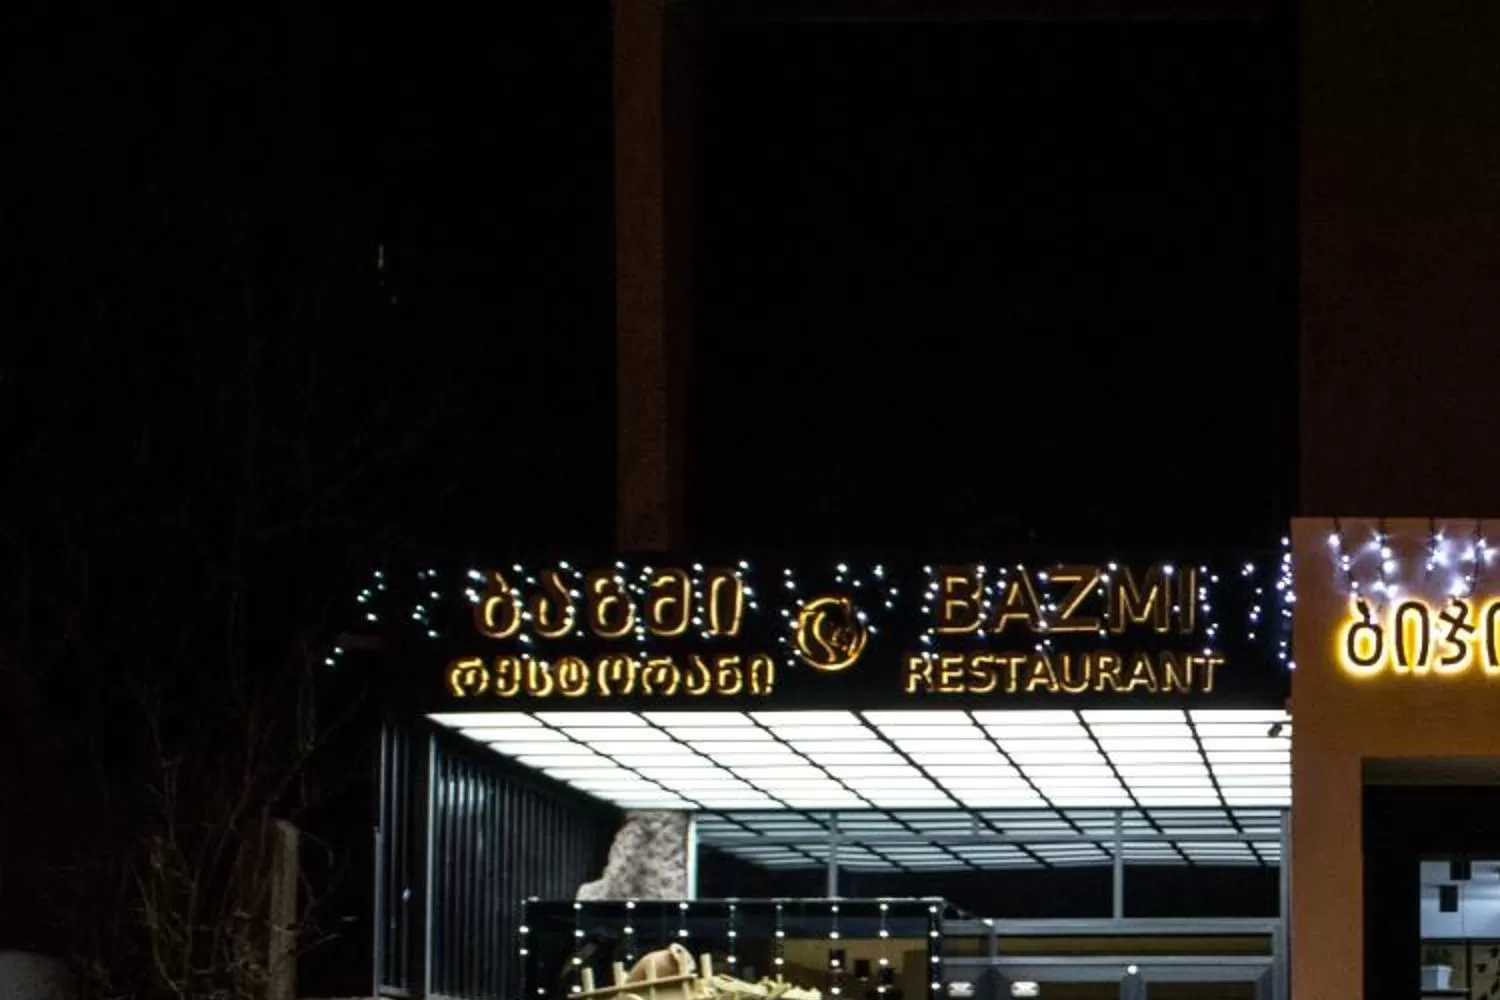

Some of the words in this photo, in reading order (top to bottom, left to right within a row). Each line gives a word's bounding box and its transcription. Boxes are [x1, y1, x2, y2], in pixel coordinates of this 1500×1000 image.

[474, 567, 744, 639] ბაზმი
[936, 566, 1198, 634] BAZMI
[450, 653, 775, 698] რესტორანი
[904, 653, 1225, 694] RESTAURANT
